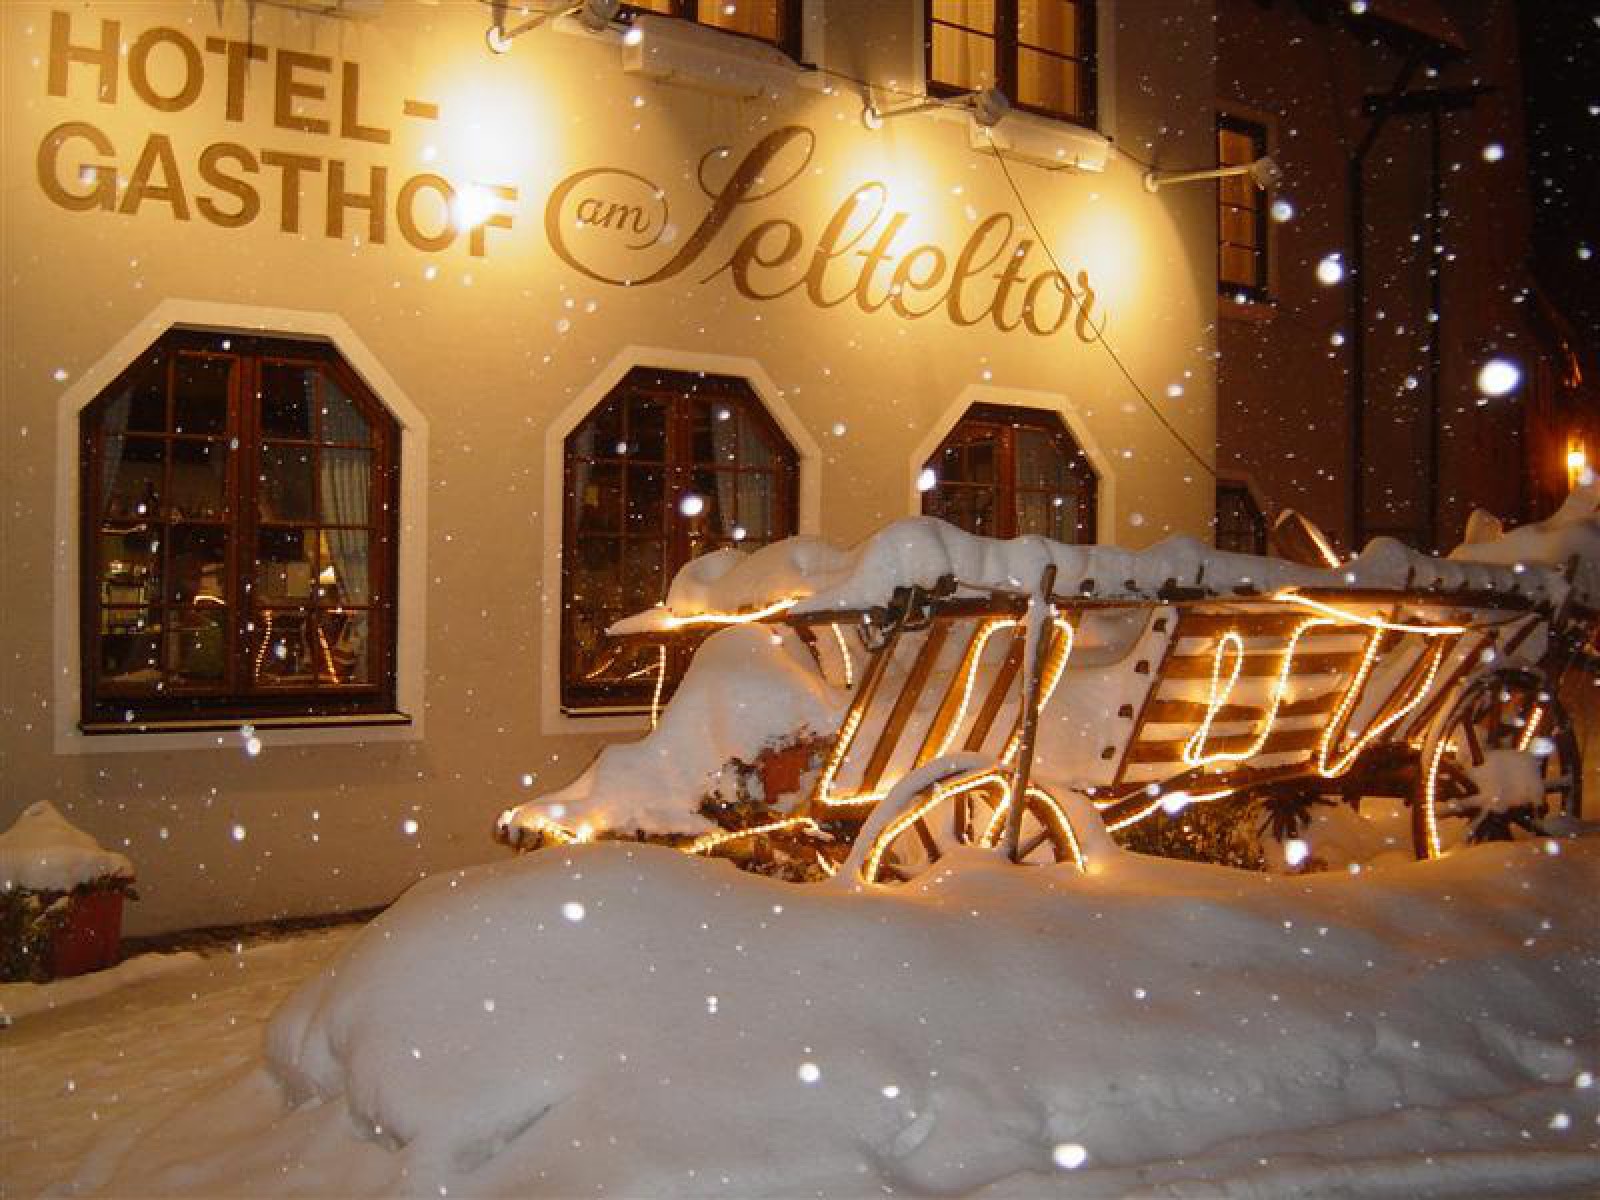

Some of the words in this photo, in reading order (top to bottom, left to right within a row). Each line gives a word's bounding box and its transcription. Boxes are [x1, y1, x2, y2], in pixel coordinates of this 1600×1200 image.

[36, 121, 518, 257] GASTHOF
[575, 195, 651, 234] am
[640, 125, 1106, 343] Selteltor
